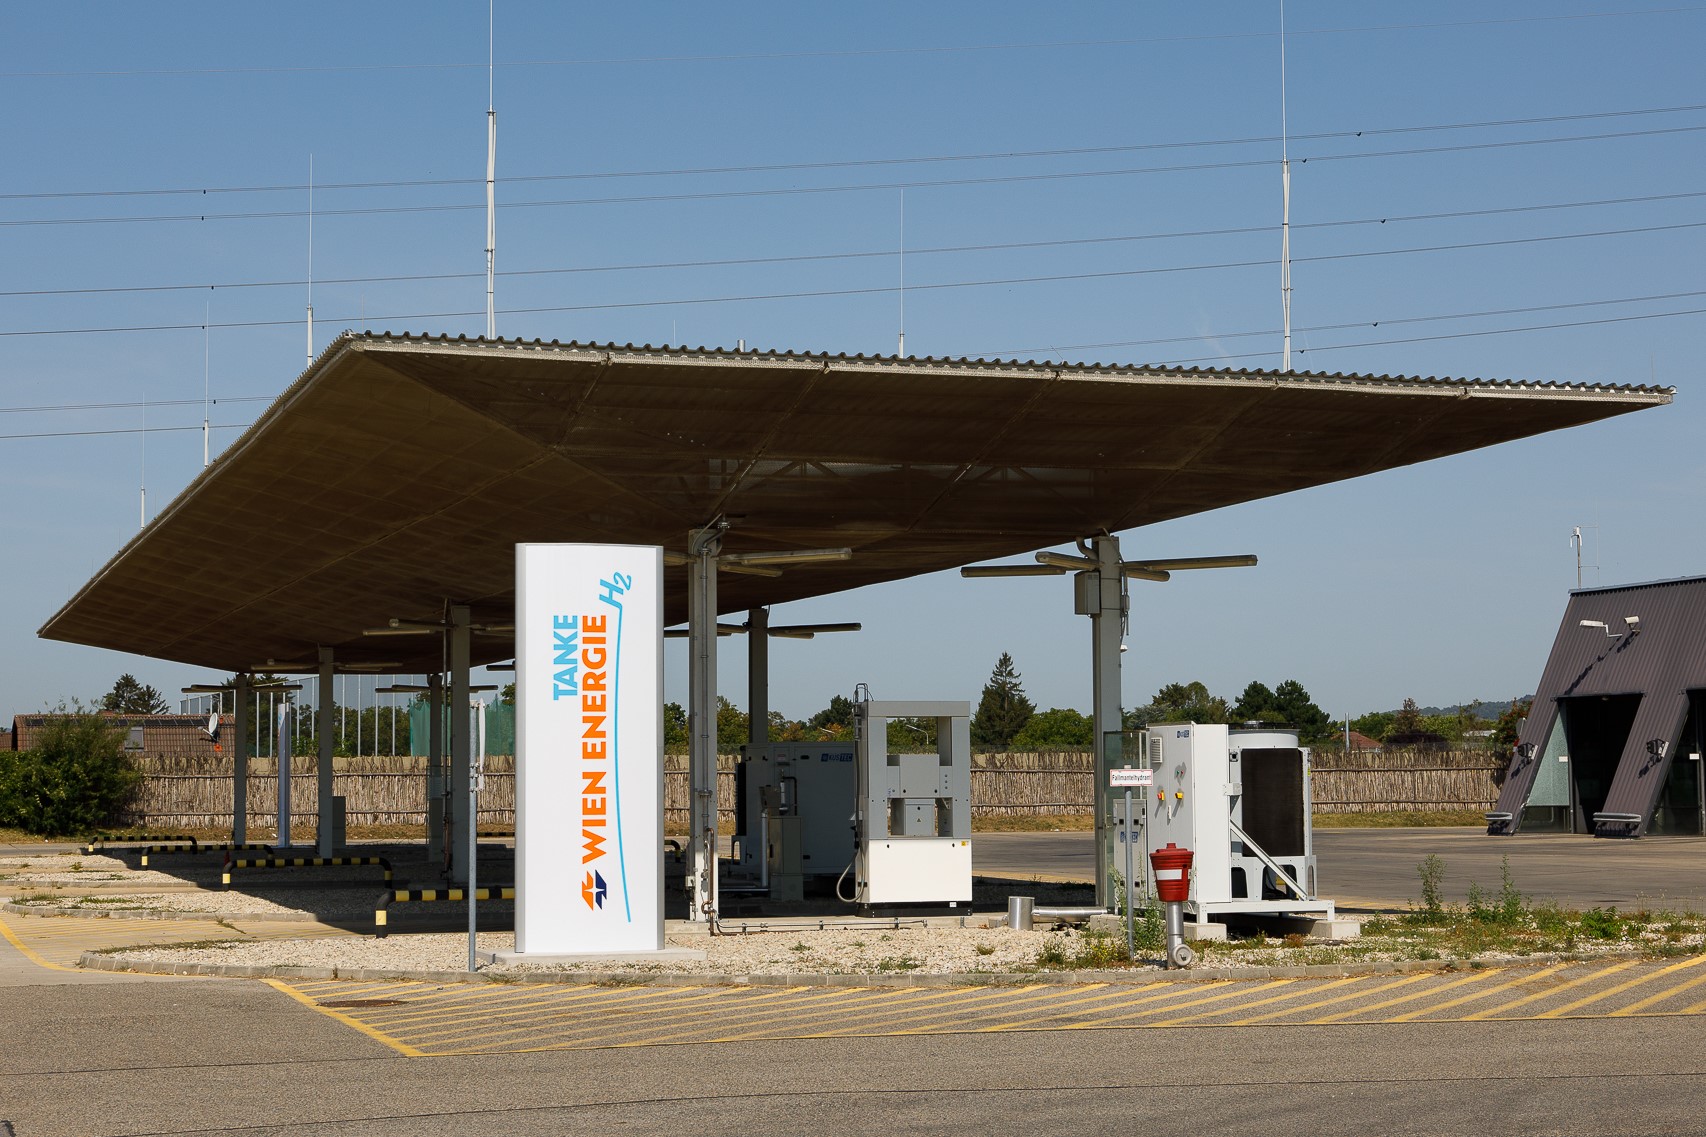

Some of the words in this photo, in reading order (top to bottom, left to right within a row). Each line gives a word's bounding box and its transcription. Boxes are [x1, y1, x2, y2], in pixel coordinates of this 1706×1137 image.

[553, 615, 578, 700] TANKE
[582, 615, 607, 759] ENERGIE
[582, 771, 607, 864] WIEN
